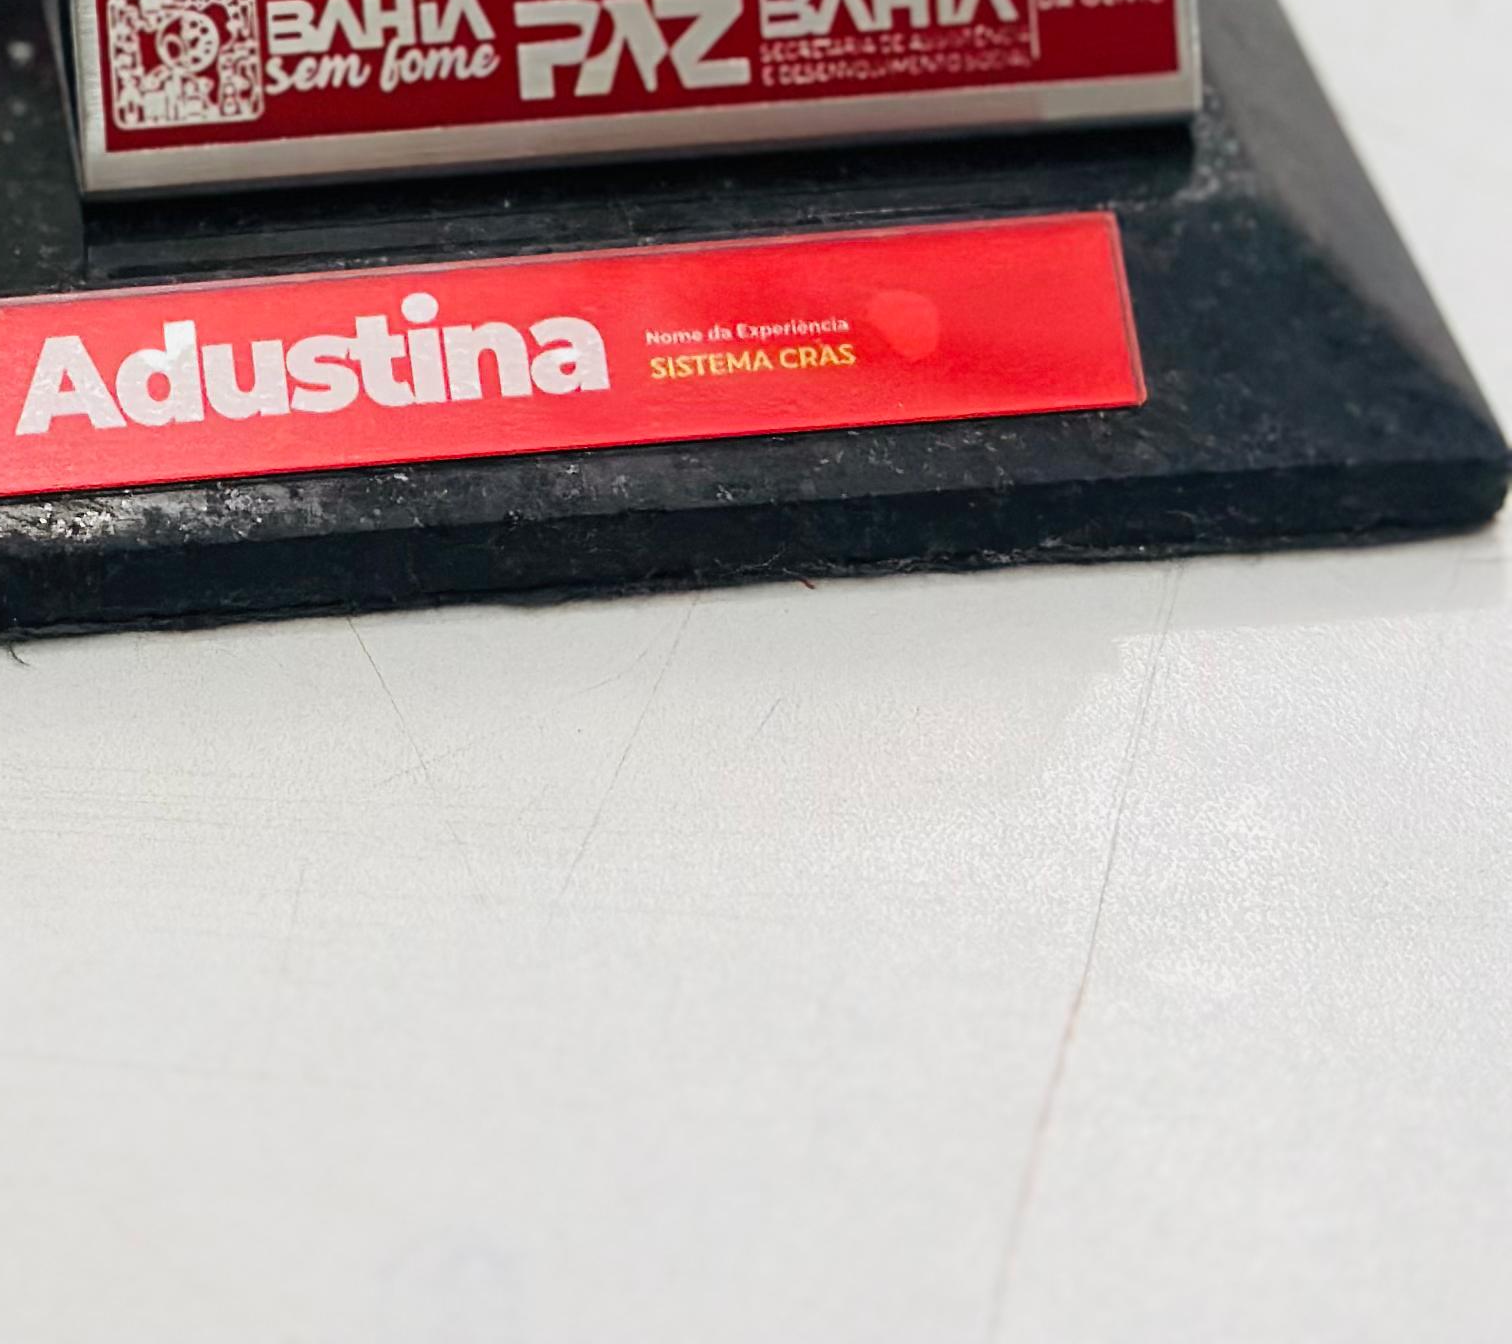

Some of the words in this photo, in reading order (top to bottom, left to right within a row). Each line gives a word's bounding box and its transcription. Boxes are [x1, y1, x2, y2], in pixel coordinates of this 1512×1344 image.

[265, 53, 372, 95] sem
[380, 35, 500, 92] fome
[644, 328, 703, 346] Nome
[707, 323, 734, 341] da
[736, 316, 850, 341] Experiência
[15, 291, 610, 435] Adustina
[649, 348, 773, 380] SISTEMA
[779, 343, 857, 370] CRAS
